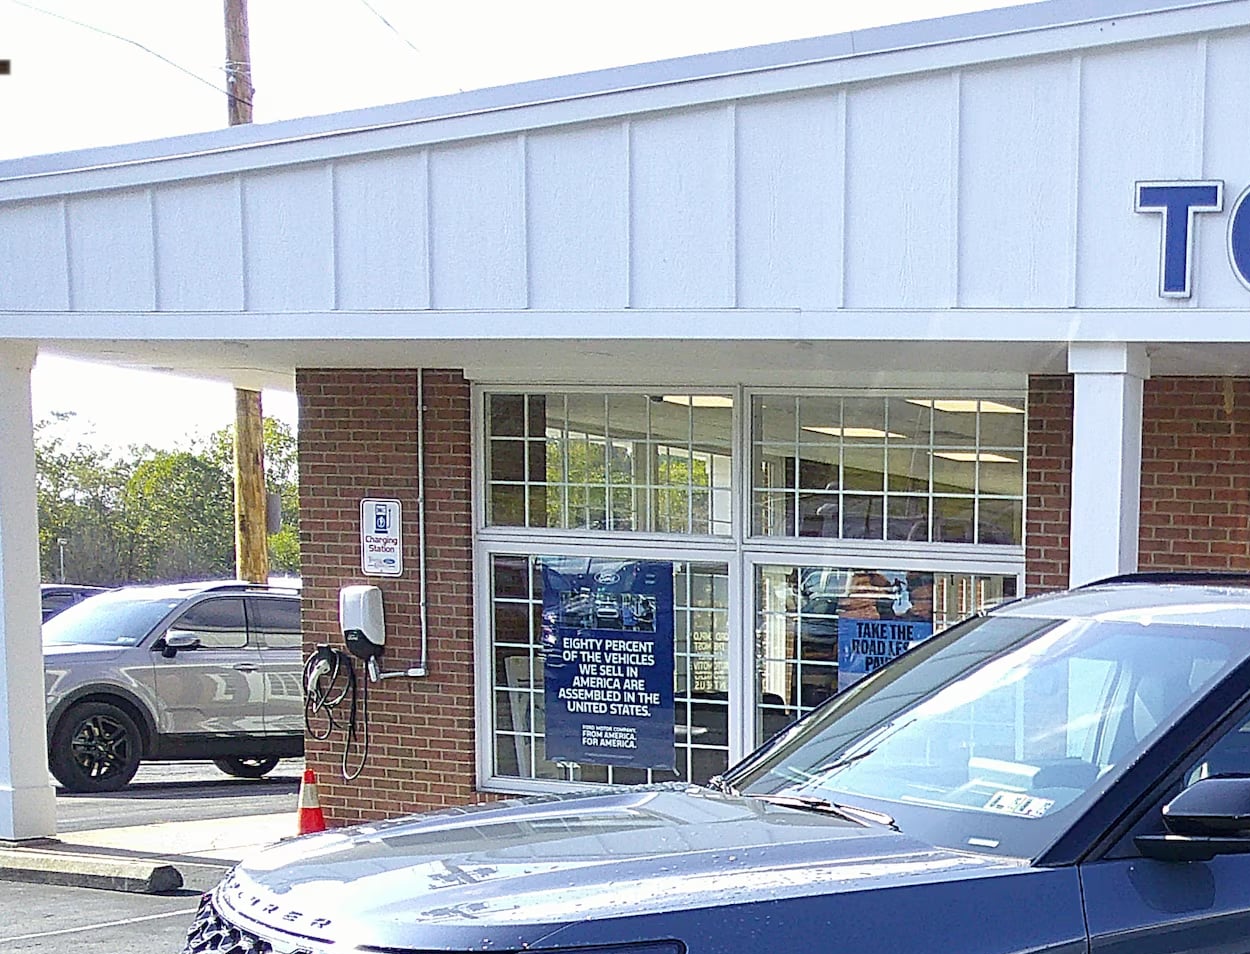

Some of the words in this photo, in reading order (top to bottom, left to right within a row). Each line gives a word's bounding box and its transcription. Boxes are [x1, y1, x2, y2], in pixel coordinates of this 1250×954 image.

[365, 535, 398, 546] Charging
[368, 544, 395, 553] Station
[857, 622, 887, 639] TAKE
[890, 624, 913, 641] THE
[563, 637, 602, 650] EIGHTY
[605, 640, 654, 653] PERCENT
[852, 638, 886, 656] ROAD
[562, 650, 577, 661] OF
[580, 651, 601, 663] THE
[604, 652, 655, 666] VEHICLES
[579, 663, 597, 675] WE
[599, 665, 624, 677] SELL
[626, 666, 638, 678] IN
[573, 676, 620, 690] AMERICA
[623, 679, 645, 691] ARE
[558, 687, 621, 702] ASSEMBLED
[623, 691, 635, 703] IN
[637, 692, 660, 704] THE
[567, 700, 607, 714] UNITED
[609, 703, 651, 717] STATES.
[582, 730, 602, 738] FROM
[604, 731, 637, 741] AMERICA.
[582, 737, 598, 746] FOR
[600, 738, 637, 749] AMERICA.
